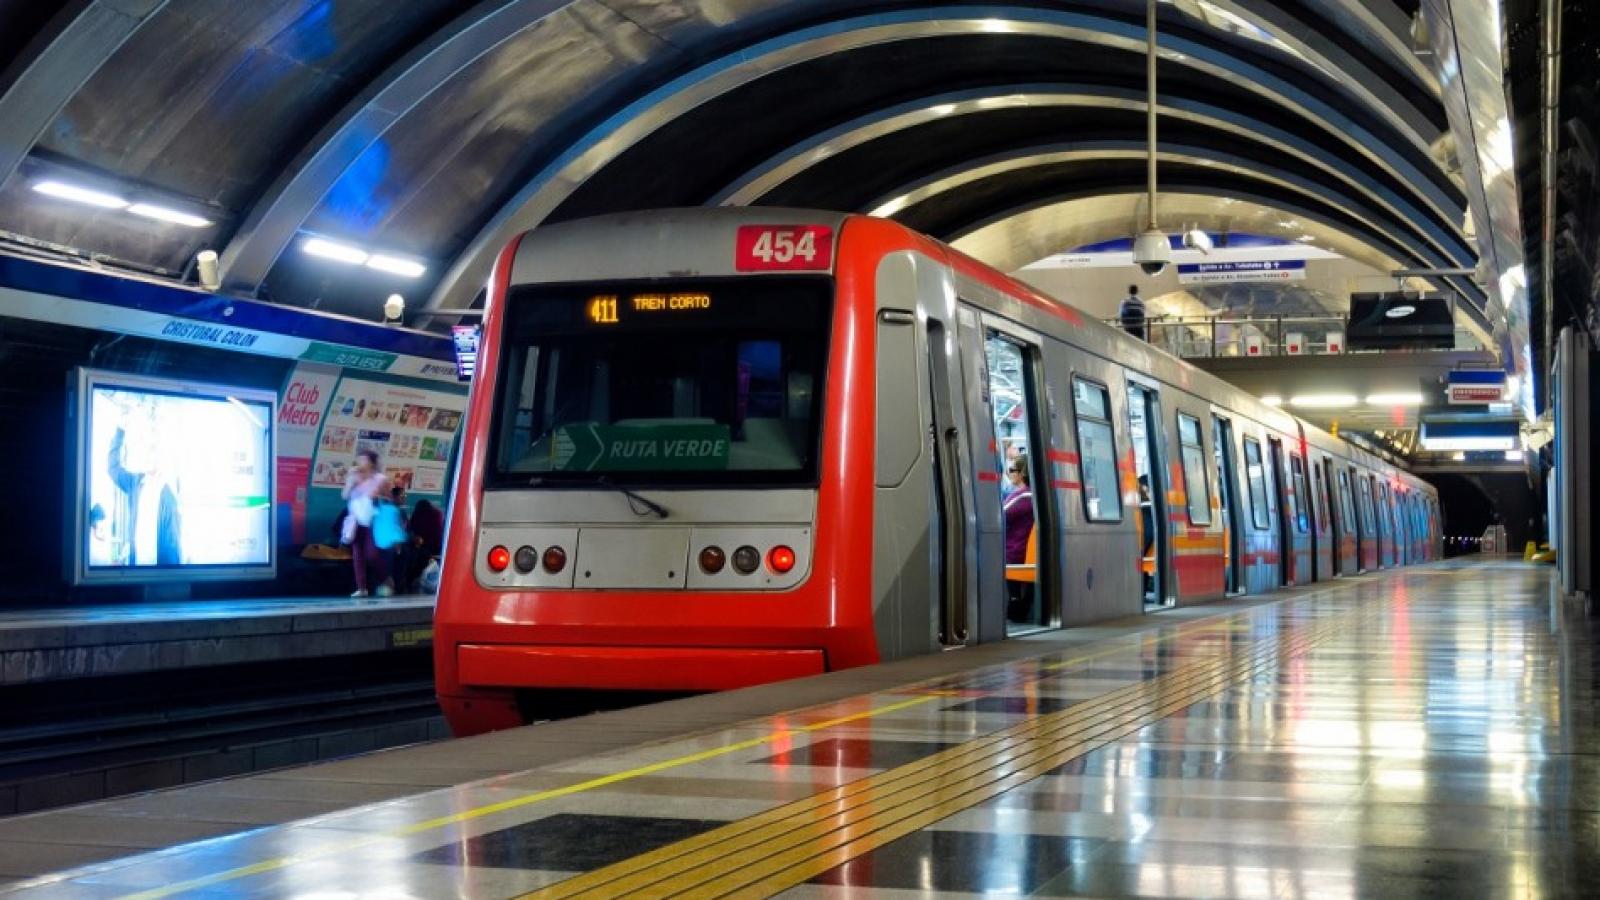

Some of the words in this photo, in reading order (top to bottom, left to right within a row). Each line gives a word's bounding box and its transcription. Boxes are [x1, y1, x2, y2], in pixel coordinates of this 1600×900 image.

[752, 231, 816, 263] 454
[591, 297, 619, 322] 411
[634, 297, 666, 310] TREN
[669, 296, 710, 309] CORTO
[287, 382, 320, 404] Club
[279, 404, 320, 426] Metro
[610, 440, 657, 457] RUTA
[664, 439, 725, 457] VERDE
